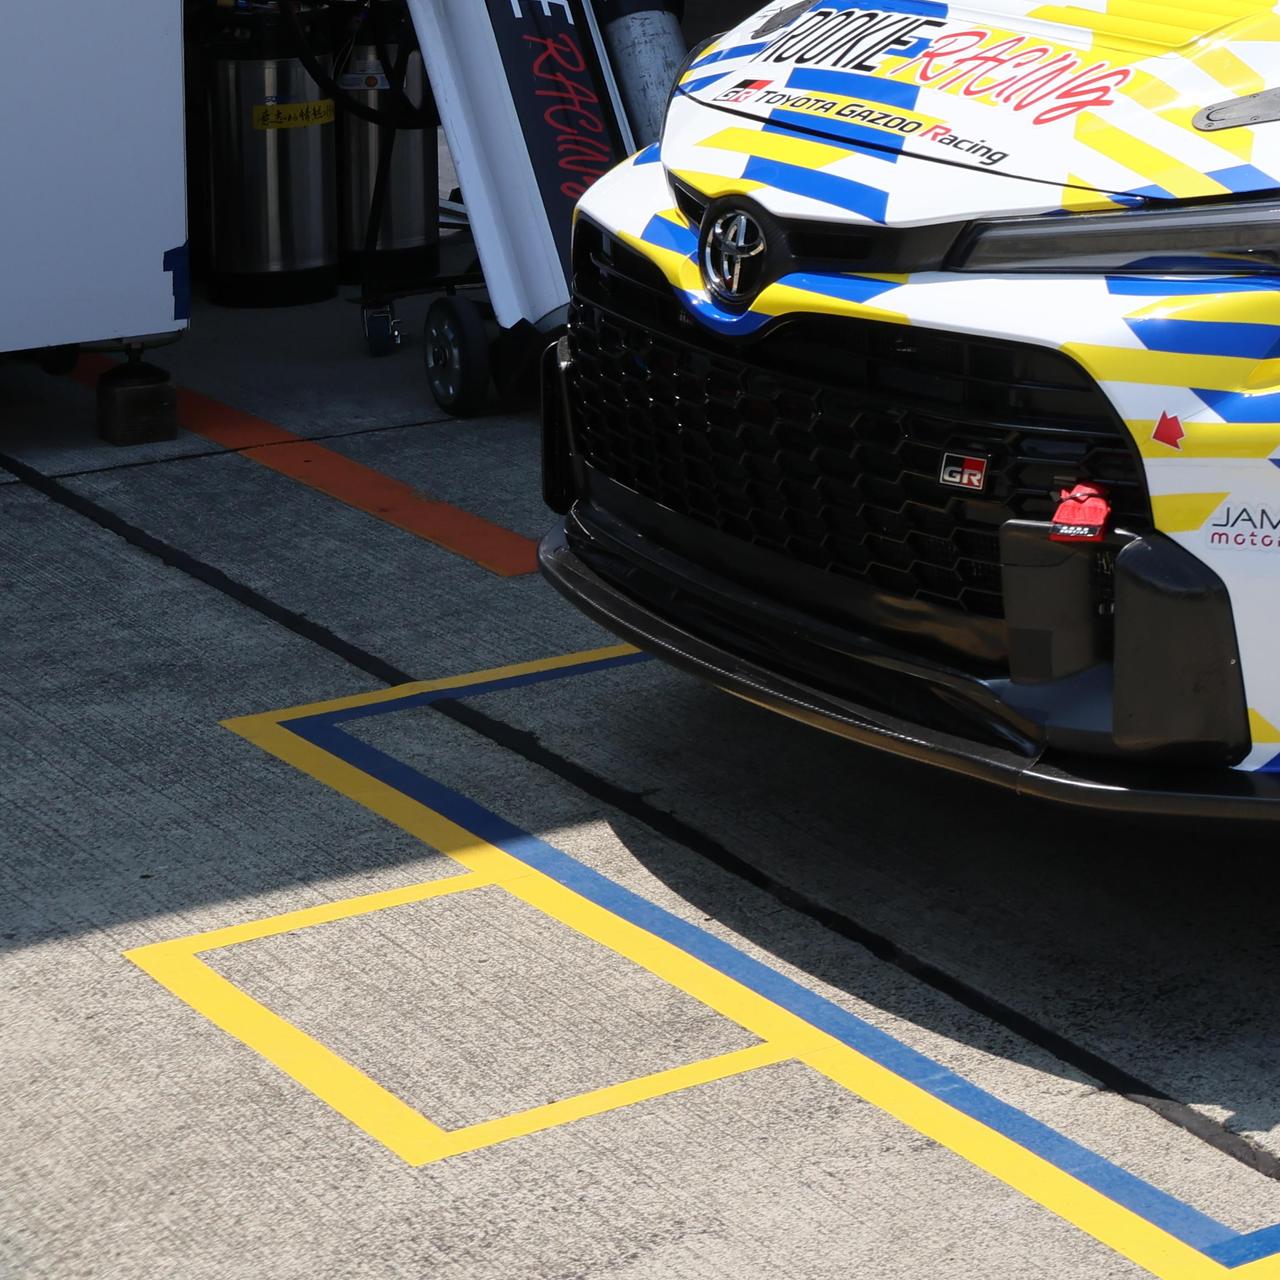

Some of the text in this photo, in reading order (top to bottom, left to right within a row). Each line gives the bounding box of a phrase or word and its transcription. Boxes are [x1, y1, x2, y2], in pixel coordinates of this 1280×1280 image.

[751, 9, 1134, 126] ROOKIE RACING
[718, 85, 754, 103] GR
[753, 88, 1010, 167] TOYOTA GAZOO Racing
[942, 466, 983, 488] GR
